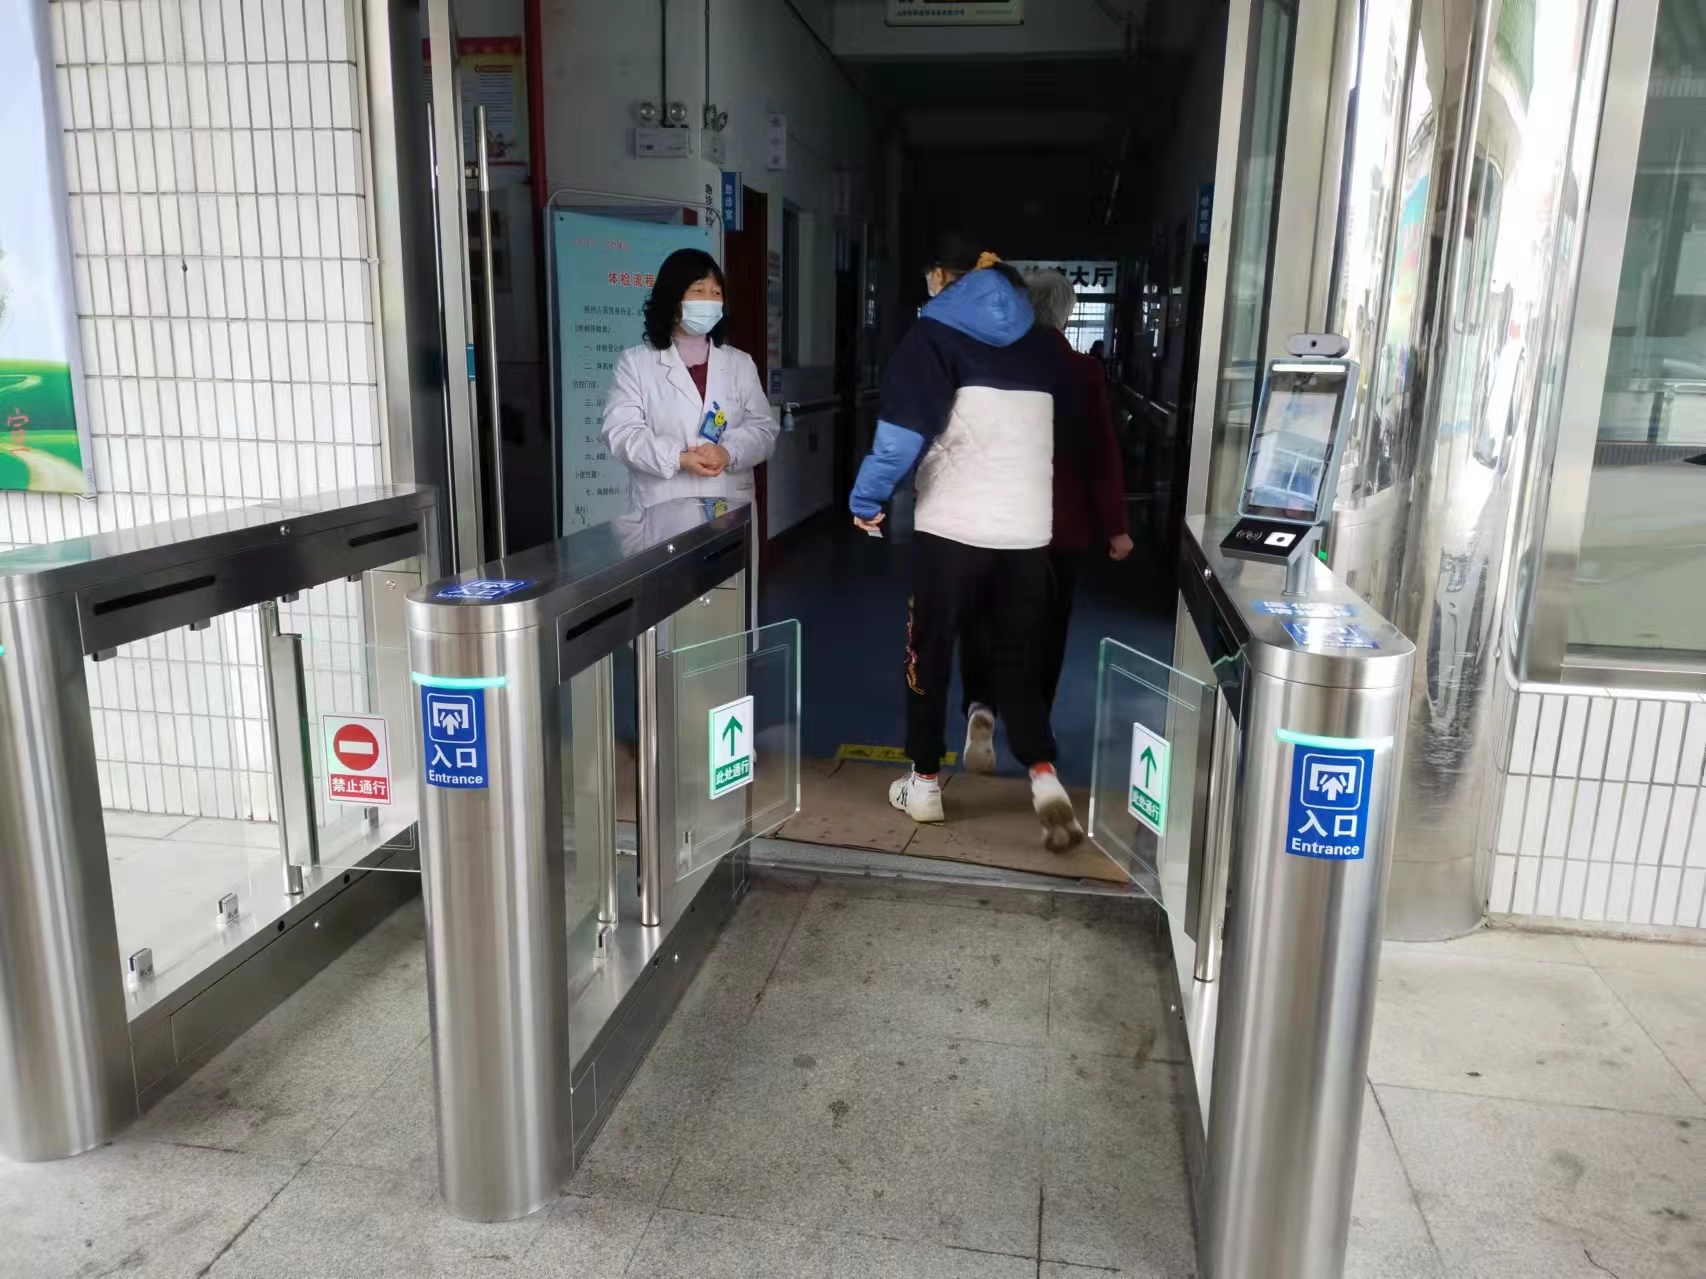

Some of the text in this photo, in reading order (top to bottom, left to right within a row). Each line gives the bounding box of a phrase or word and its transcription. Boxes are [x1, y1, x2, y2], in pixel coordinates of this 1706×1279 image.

[431, 744, 478, 769] 入口
[429, 769, 484, 785] Entrance
[716, 759, 749, 785] 此处通行
[332, 778, 387, 796] 禁止通行
[1297, 809, 1358, 838] 入口
[1291, 837, 1360, 856] Entrance
